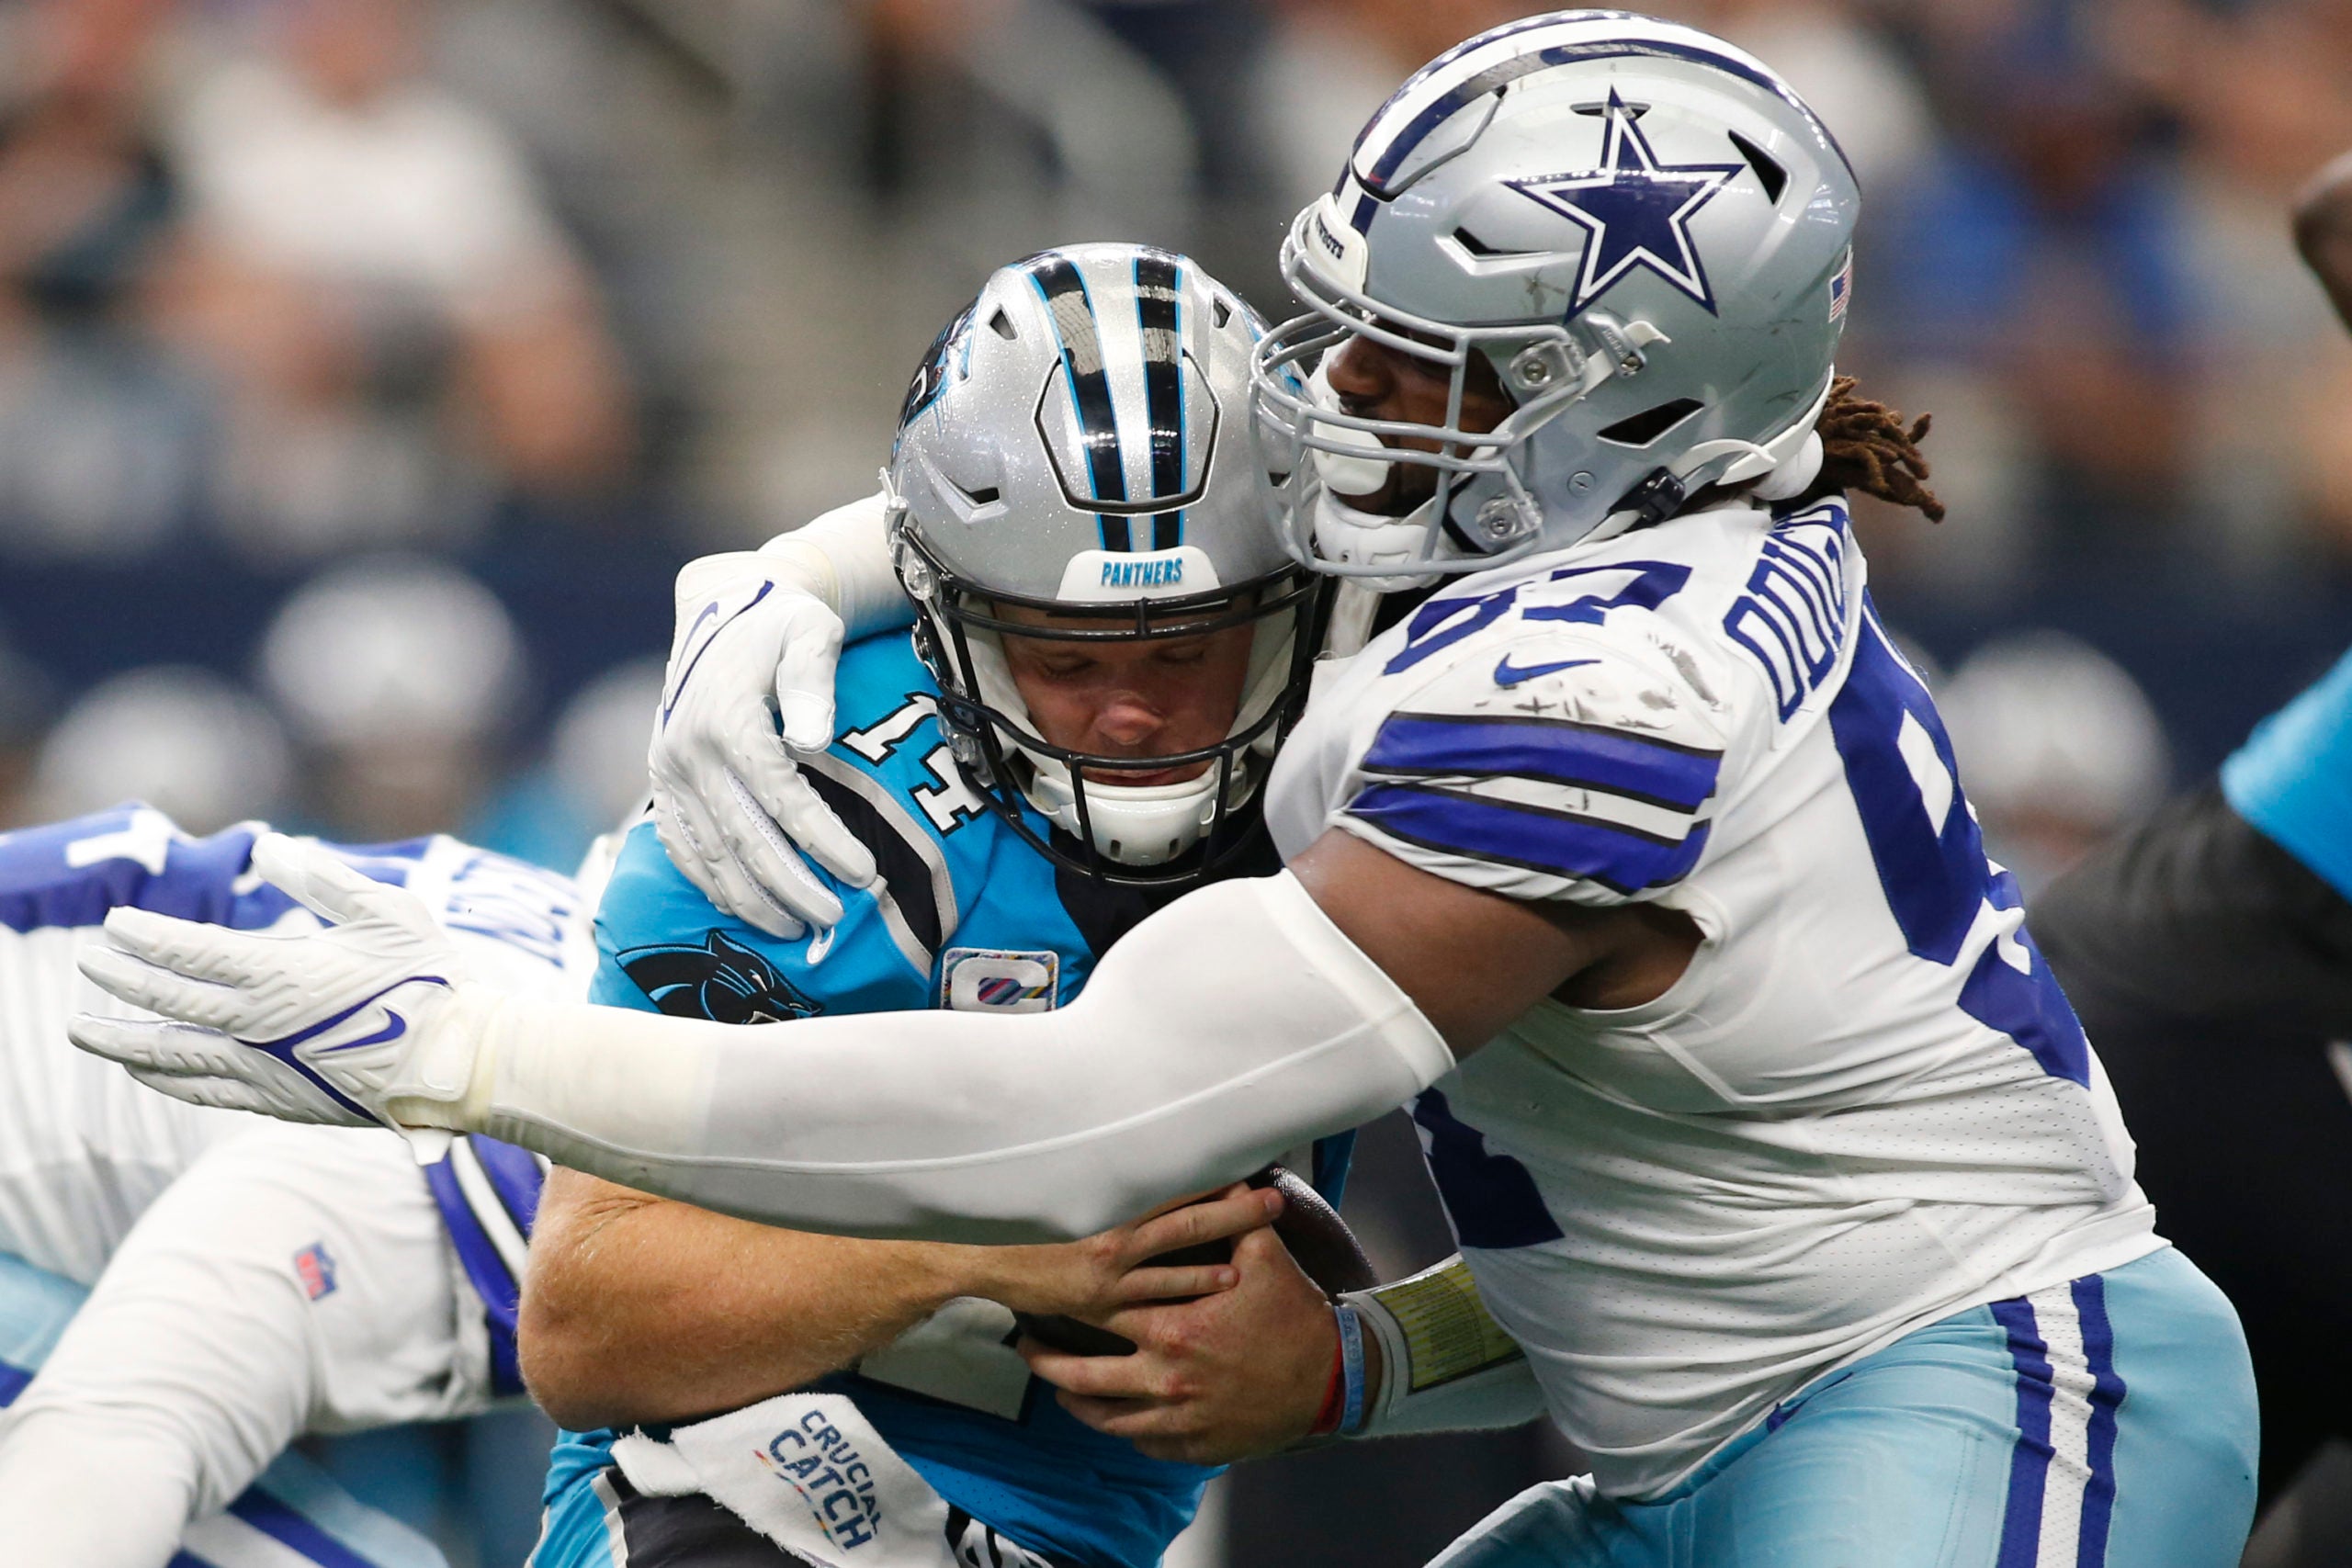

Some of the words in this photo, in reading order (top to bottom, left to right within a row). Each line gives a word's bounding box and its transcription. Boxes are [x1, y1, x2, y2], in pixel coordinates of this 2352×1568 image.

[1102, 558, 1182, 586] PANTHERS
[834, 691, 989, 838] 14
[770, 1429, 873, 1550] CATCH
[801, 1410, 881, 1535] CRUCIAL
